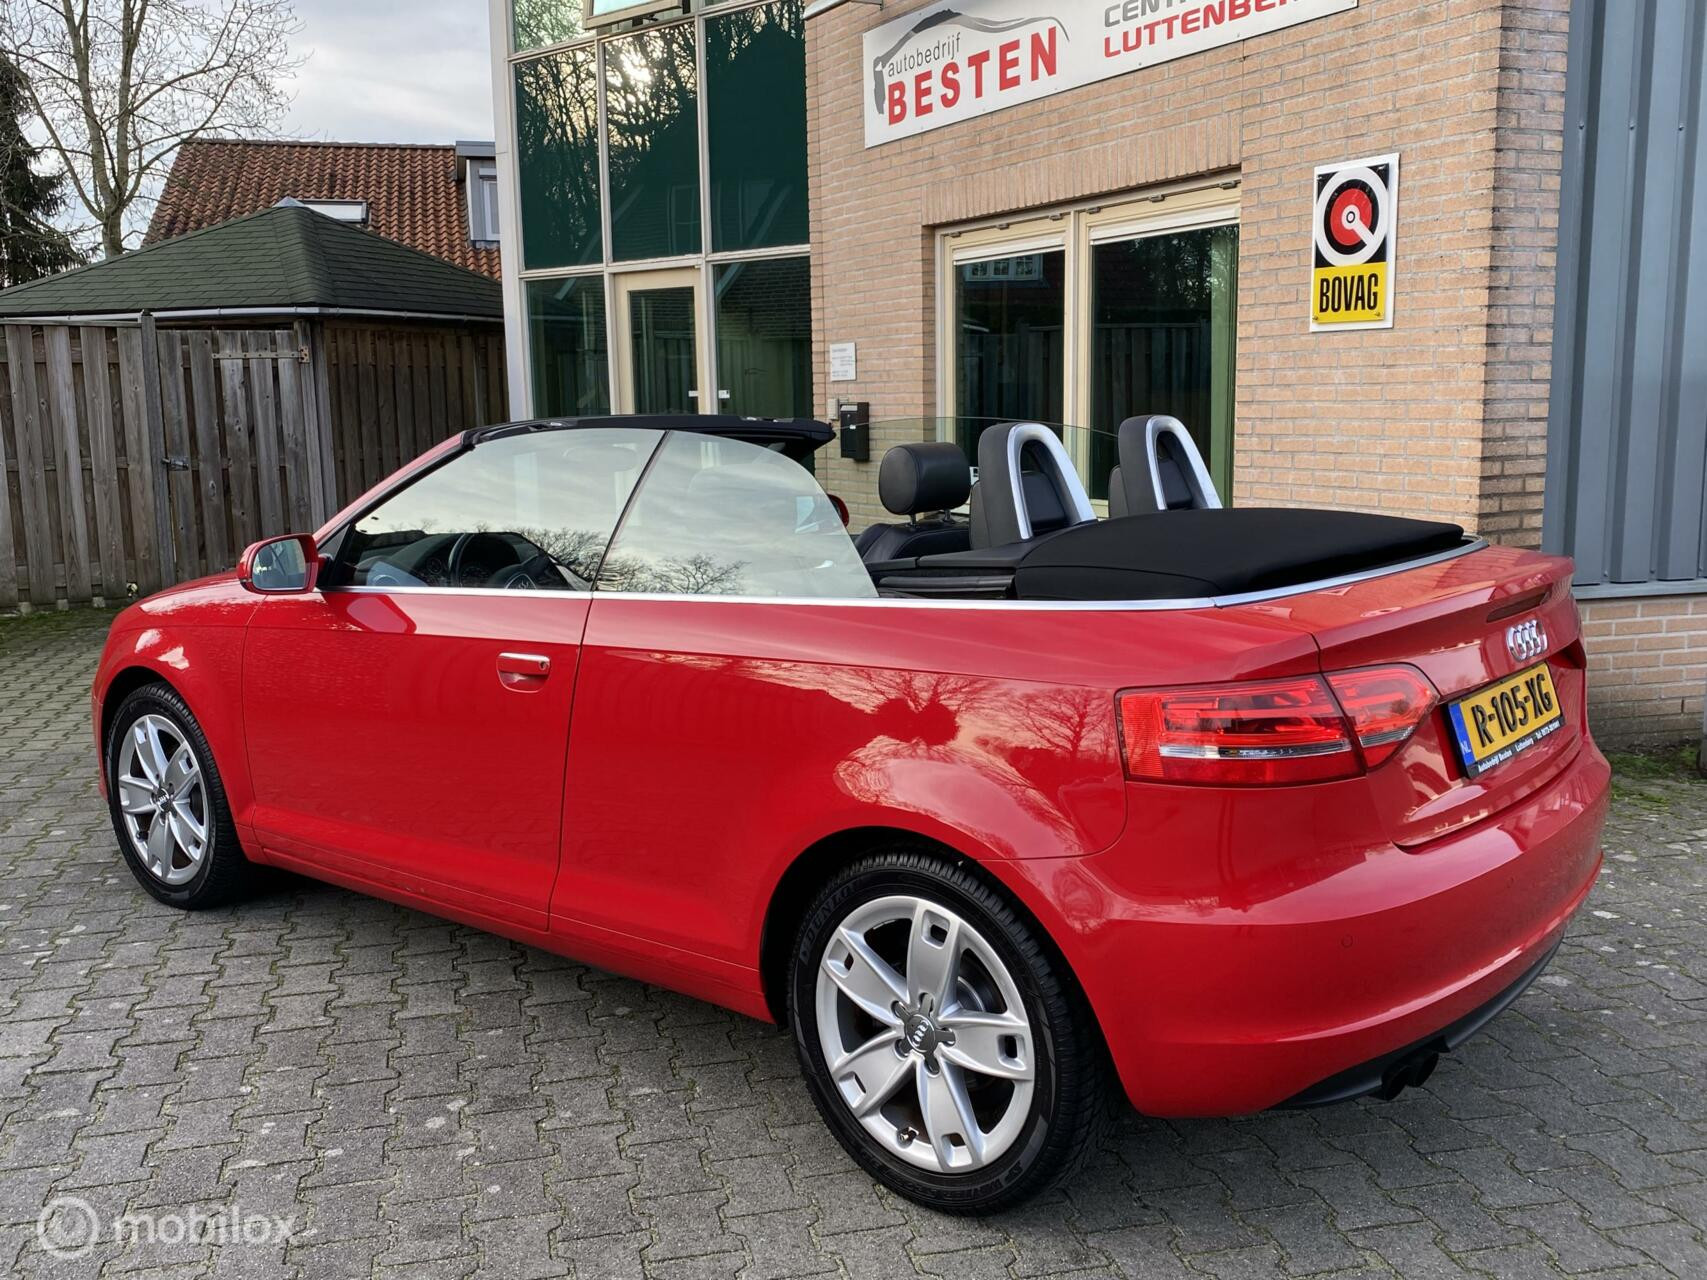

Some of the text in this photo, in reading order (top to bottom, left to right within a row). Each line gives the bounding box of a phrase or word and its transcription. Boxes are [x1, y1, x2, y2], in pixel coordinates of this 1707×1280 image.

[1104, 0, 1185, 27] CEN
[1104, 0, 1297, 58] LUTTENBE
[888, 32, 961, 77] autobedrijf
[888, 26, 1057, 126] BESTEN
[1319, 273, 1379, 313] BOVAG
[1471, 673, 1553, 748] R-105-XG
[1460, 741, 1472, 756] NL
